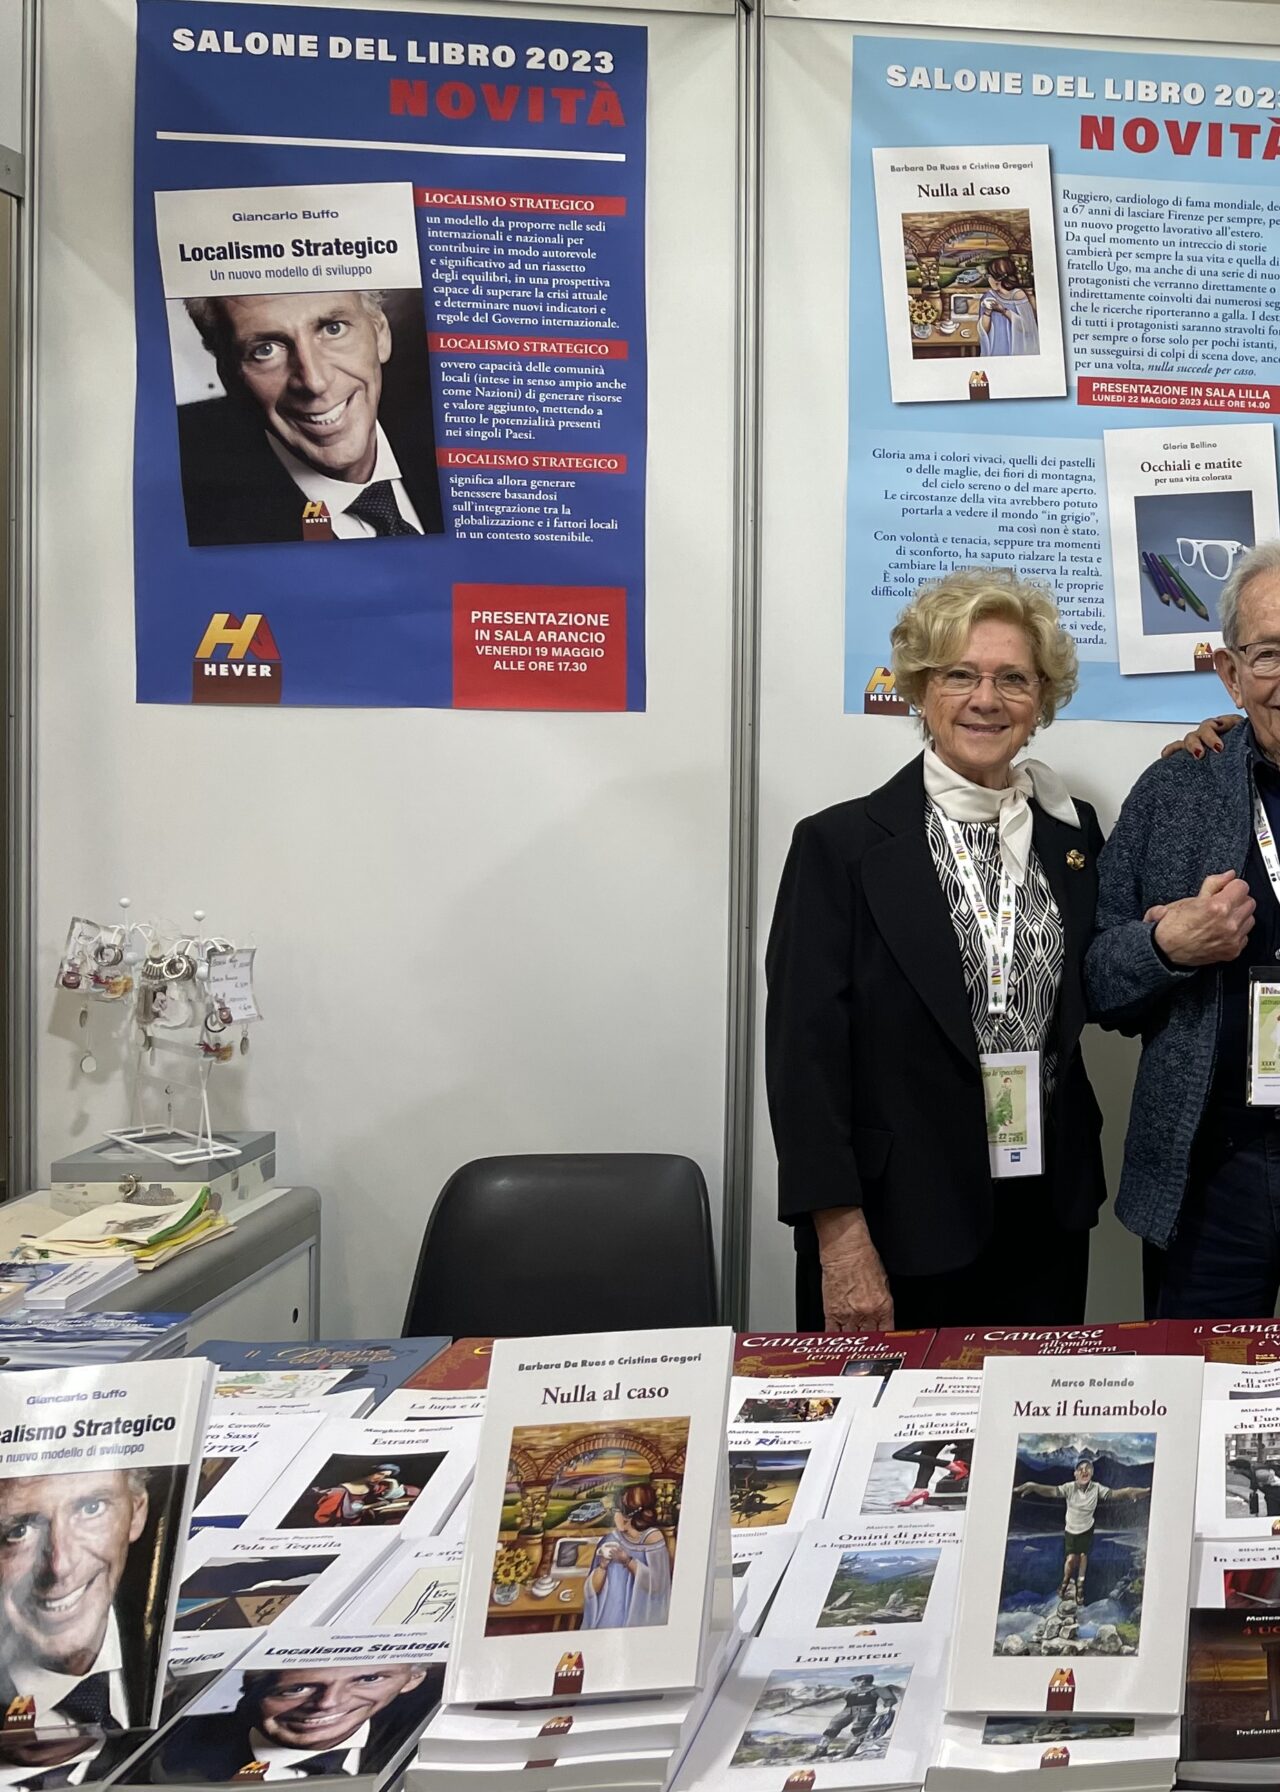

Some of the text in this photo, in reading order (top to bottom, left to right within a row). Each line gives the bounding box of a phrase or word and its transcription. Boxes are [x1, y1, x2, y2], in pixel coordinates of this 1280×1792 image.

[172, 28, 614, 73] SALONE DEL LIBRO 2023
[885, 64, 1022, 93] SALONE
[1032, 73, 1094, 98] DEL
[1104, 78, 1205, 104] LIBRO
[389, 79, 627, 128] NOVITÀ
[917, 181, 1010, 198] Nulla al caso
[424, 192, 595, 211] LOCALISMO STRATEGICO
[1062, 188, 1113, 204] Ruggiero,
[1114, 193, 1170, 209] cardiologo
[1171, 195, 1182, 207] di
[1185, 196, 1211, 208] fama
[1213, 199, 1264, 211] mondiale,
[231, 209, 339, 222] Giancarlo Buffo
[425, 214, 606, 232] un modello da proporre nelle sedi
[178, 236, 398, 262] Localismo Strategico
[209, 264, 373, 281] Un nuovo modello di sviluppo
[439, 337, 609, 355] LOCALISMO STRATEGICO
[1092, 382, 1271, 400] PRESENTAZIONE IN SALA LILLA
[1091, 393, 1271, 409] LUNEDI 22 MAGGIO 2023 ALLE ORE 14.00
[1140, 457, 1242, 473] Occhiali e matite
[470, 610, 610, 626] PRESENTAZIONE
[474, 628, 606, 643] IN SALA ARANCIO
[474, 645, 605, 658] VENERDI 19 MAGGIO
[204, 663, 272, 677] HEVER
[492, 660, 588, 672] ALLE ORE 17.30
[742, 1336, 869, 1348] Canavese
[983, 1329, 1104, 1341] Canavese
[1050, 1377, 1135, 1388] Marco Rolando
[25, 1388, 128, 1405] Giancarlo Buffo
[541, 1382, 669, 1405] Nulla al caso
[1013, 1399, 1167, 1417] Max il funambolo
[72, 1414, 176, 1438] Strategico
